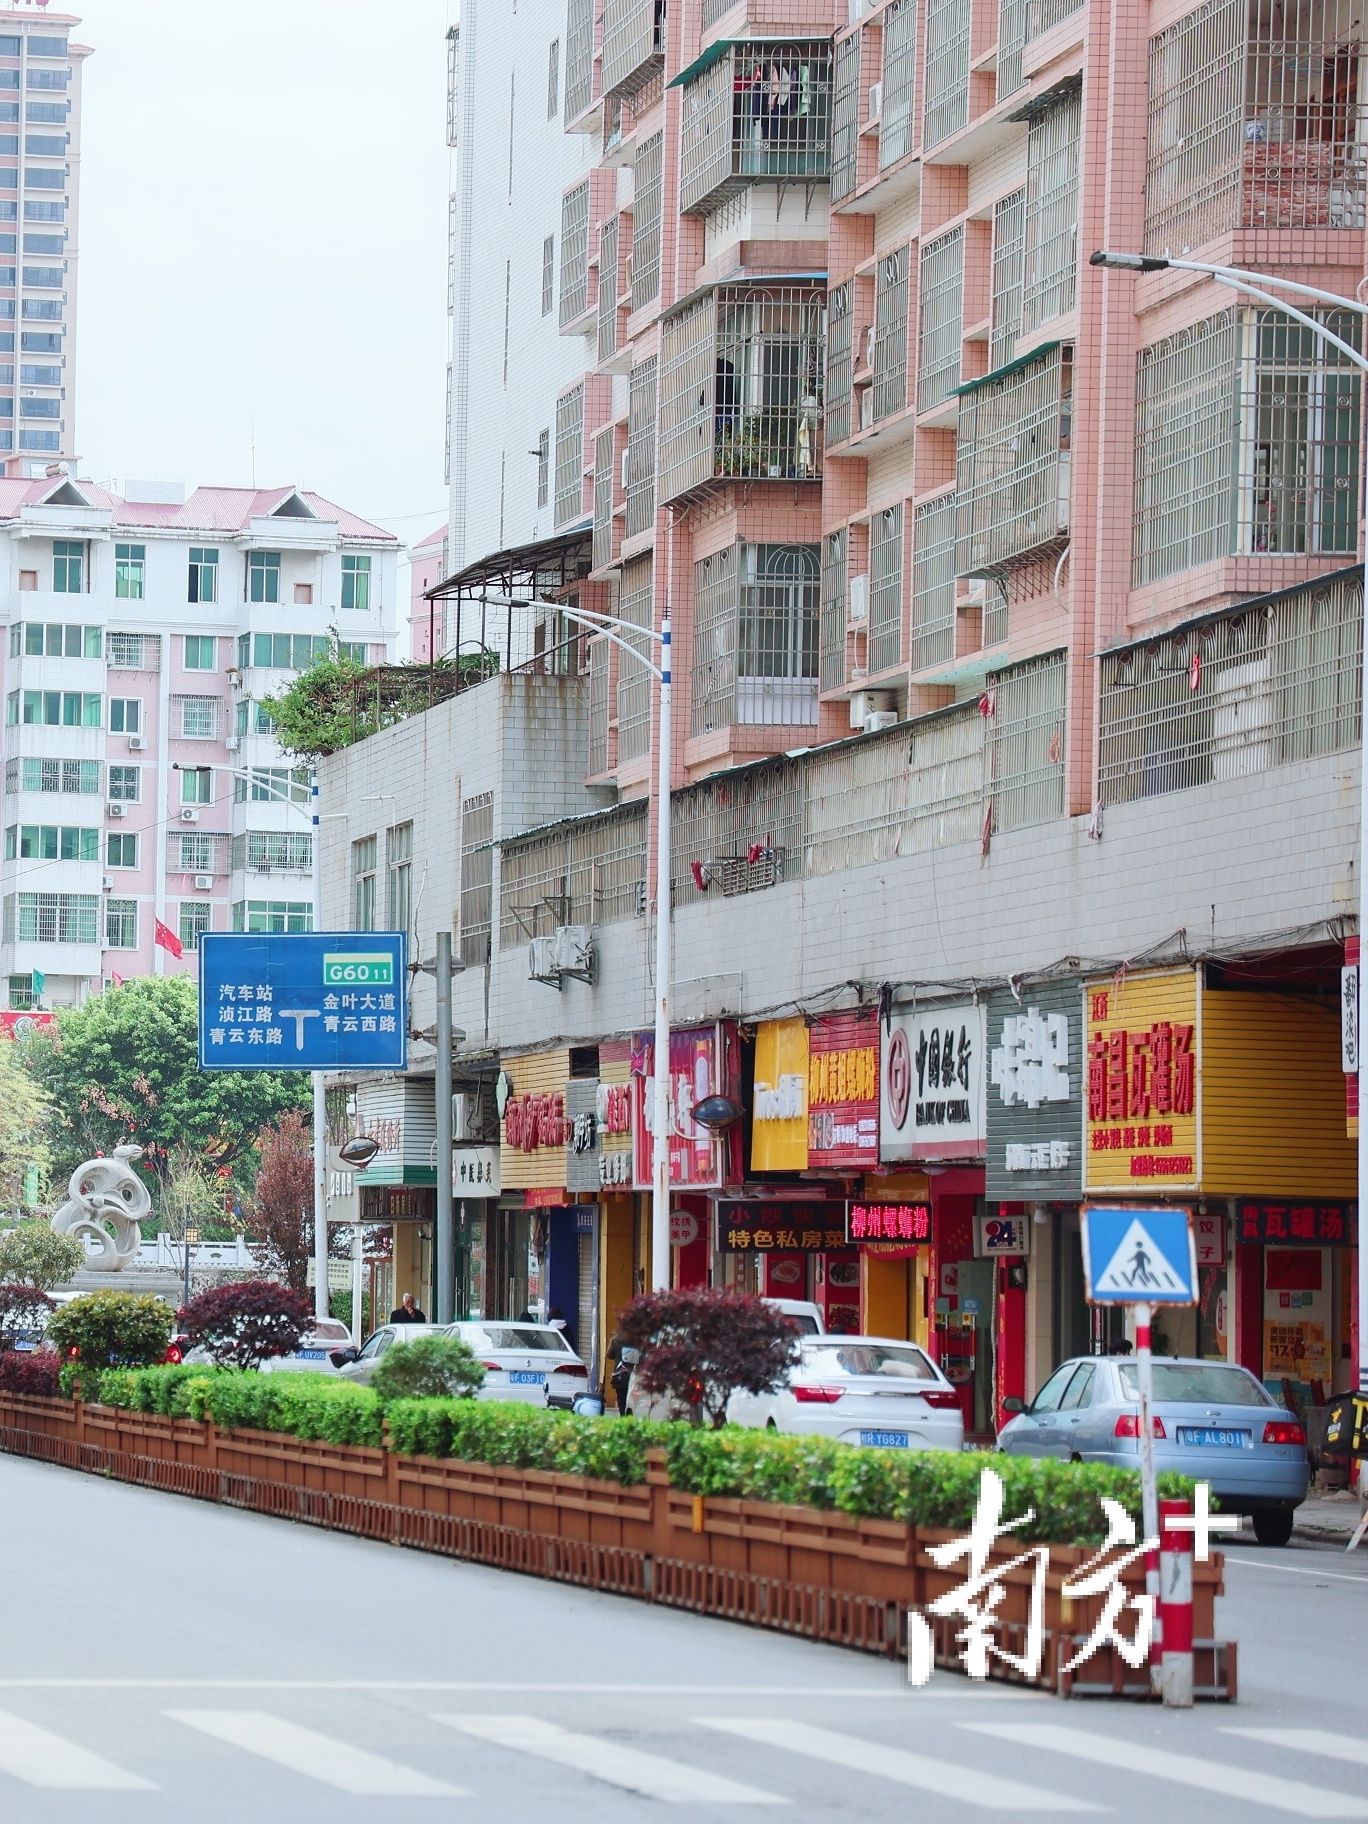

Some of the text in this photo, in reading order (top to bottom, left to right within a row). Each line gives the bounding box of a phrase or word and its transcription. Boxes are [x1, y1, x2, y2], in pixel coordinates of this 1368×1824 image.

[329, 965, 370, 981] G60
[218, 984, 273, 1002] 汽车站
[323, 993, 396, 1010] 金叶大道
[218, 1005, 273, 1023] 浈江路
[323, 1015, 397, 1033] 青云西路
[209, 1027, 284, 1045] 青云东路
[915, 1025, 972, 1098] 中国银行
[1087, 1021, 1194, 1122] 南昌瓦罐汤
[915, 1099, 971, 1127] BANK OF CHINA
[670, 1216, 691, 1228] 纹绣
[850, 1205, 929, 1238] 柳州螺蛳粉
[1242, 1206, 1344, 1239] 南昌 瓦罐汤
[670, 1230, 691, 1240] 美甲
[728, 1230, 847, 1249] 特色私房菜
[1199, 1219, 1215, 1259] 饺子
